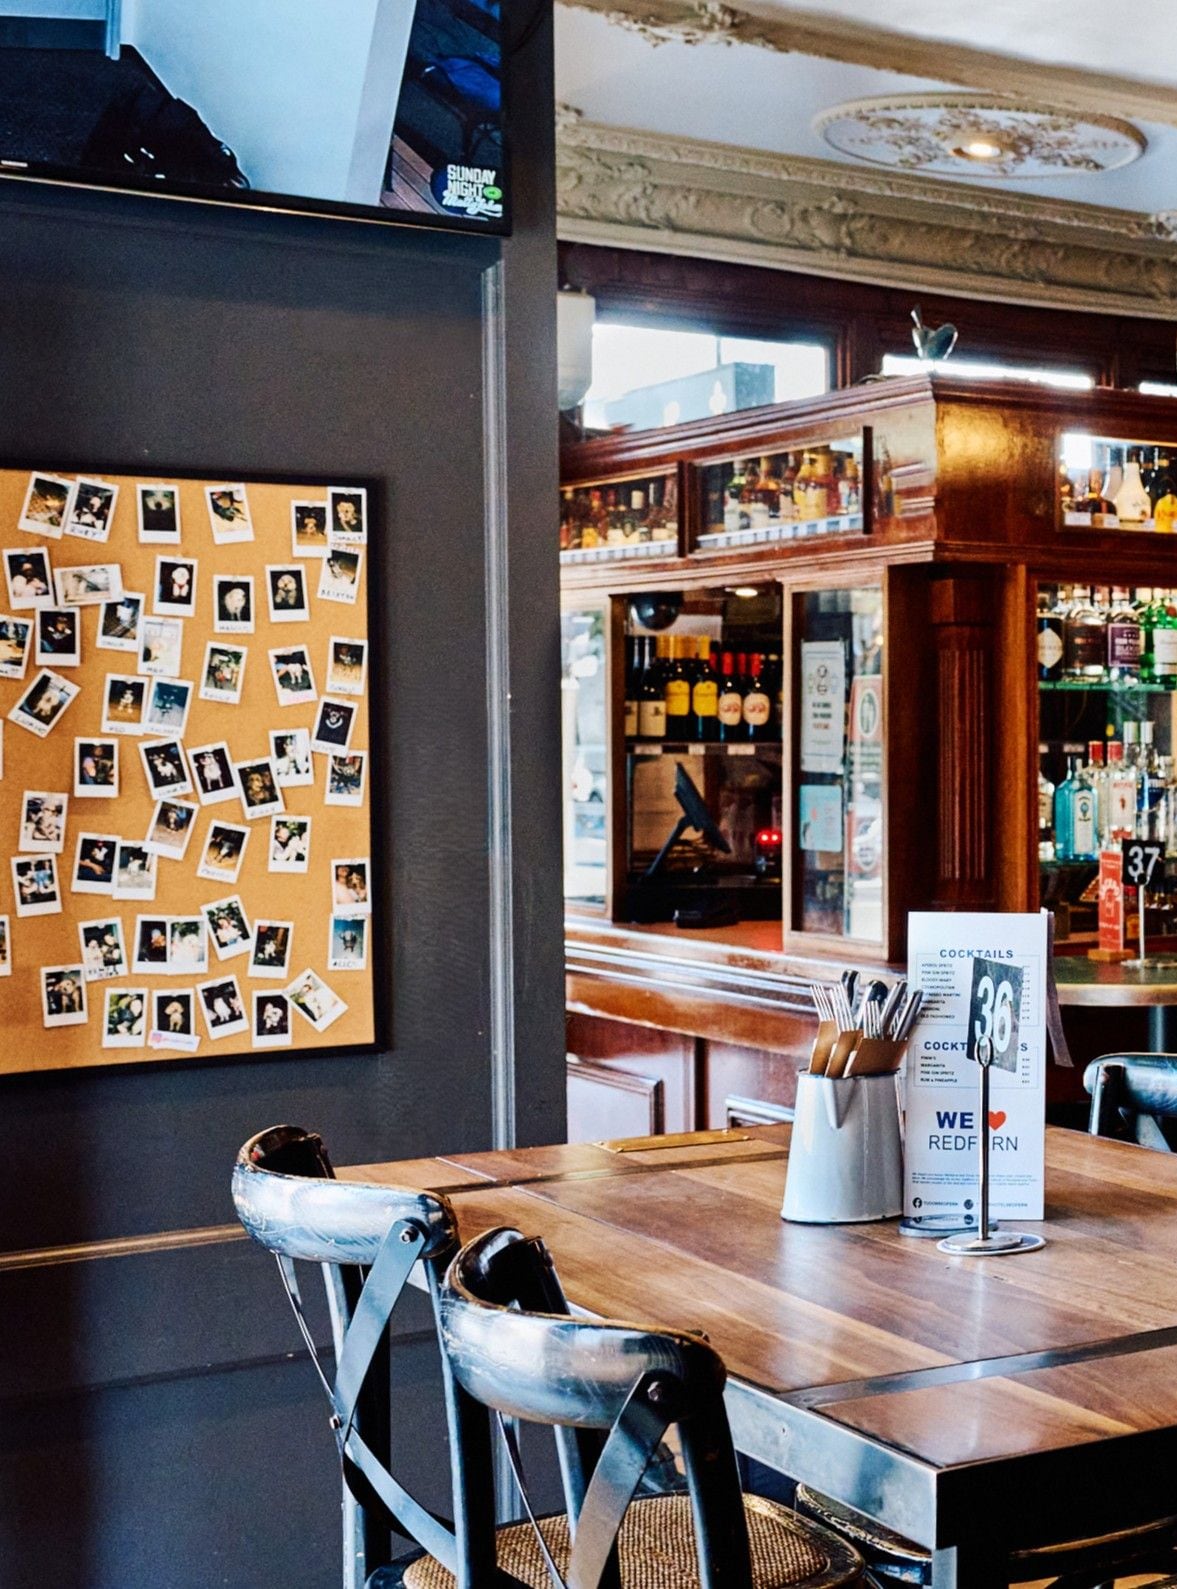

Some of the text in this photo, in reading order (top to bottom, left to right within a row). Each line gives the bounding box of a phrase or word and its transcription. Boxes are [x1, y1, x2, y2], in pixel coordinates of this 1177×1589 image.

[447, 164, 496, 185] SUNDAY
[447, 180, 484, 198] NIGHT
[1128, 845, 1160, 884] 37
[939, 949, 1014, 959] COCKTAILS
[974, 975, 1014, 1053] 36
[924, 1041, 1028, 1052] COCKTS
[936, 1111, 974, 1129] WE
[929, 1135, 1018, 1151] REDFRN
